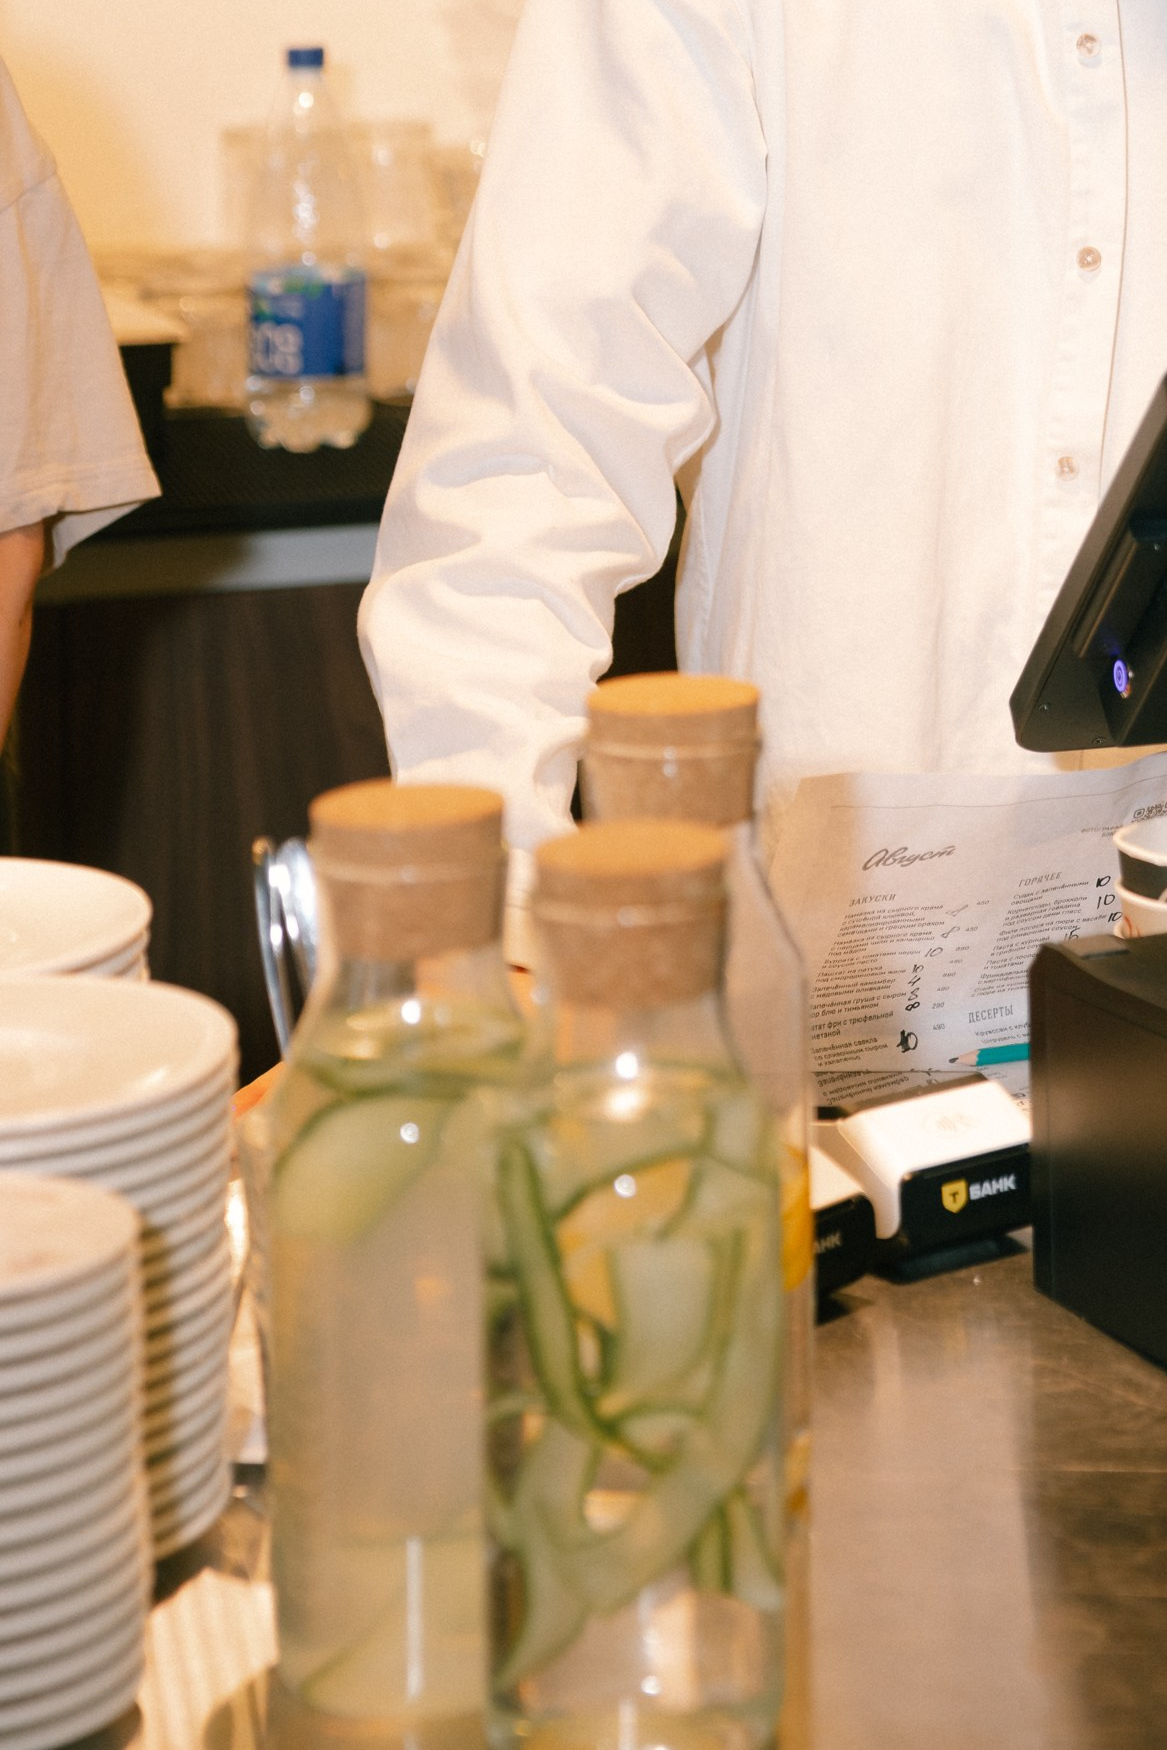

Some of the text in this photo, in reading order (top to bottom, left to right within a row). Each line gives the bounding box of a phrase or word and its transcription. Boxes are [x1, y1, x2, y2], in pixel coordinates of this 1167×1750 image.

[862, 845, 956, 871] Август
[1019, 872, 1062, 888] ГОРЯЧЕЕ
[1096, 876, 1112, 888] 10
[849, 894, 896, 907] ЗАКУСКИ
[1097, 894, 1116, 910] 10
[1108, 912, 1122, 923] 10
[924, 947, 944, 957] 10
[908, 975, 921, 987] 4
[883, 992, 907, 1000] сыром
[845, 1003, 879, 1012] тимьяном
[932, 1002, 945, 1010] 290
[827, 1020, 842, 1029] фри
[849, 1011, 894, 1024] трюфельной
[969, 1005, 1013, 1023] ДЕСЕРТЫ
[854, 1037, 878, 1046] свекла
[969, 1173, 1016, 1200] БАНК
[814, 1231, 842, 1254] АНК
